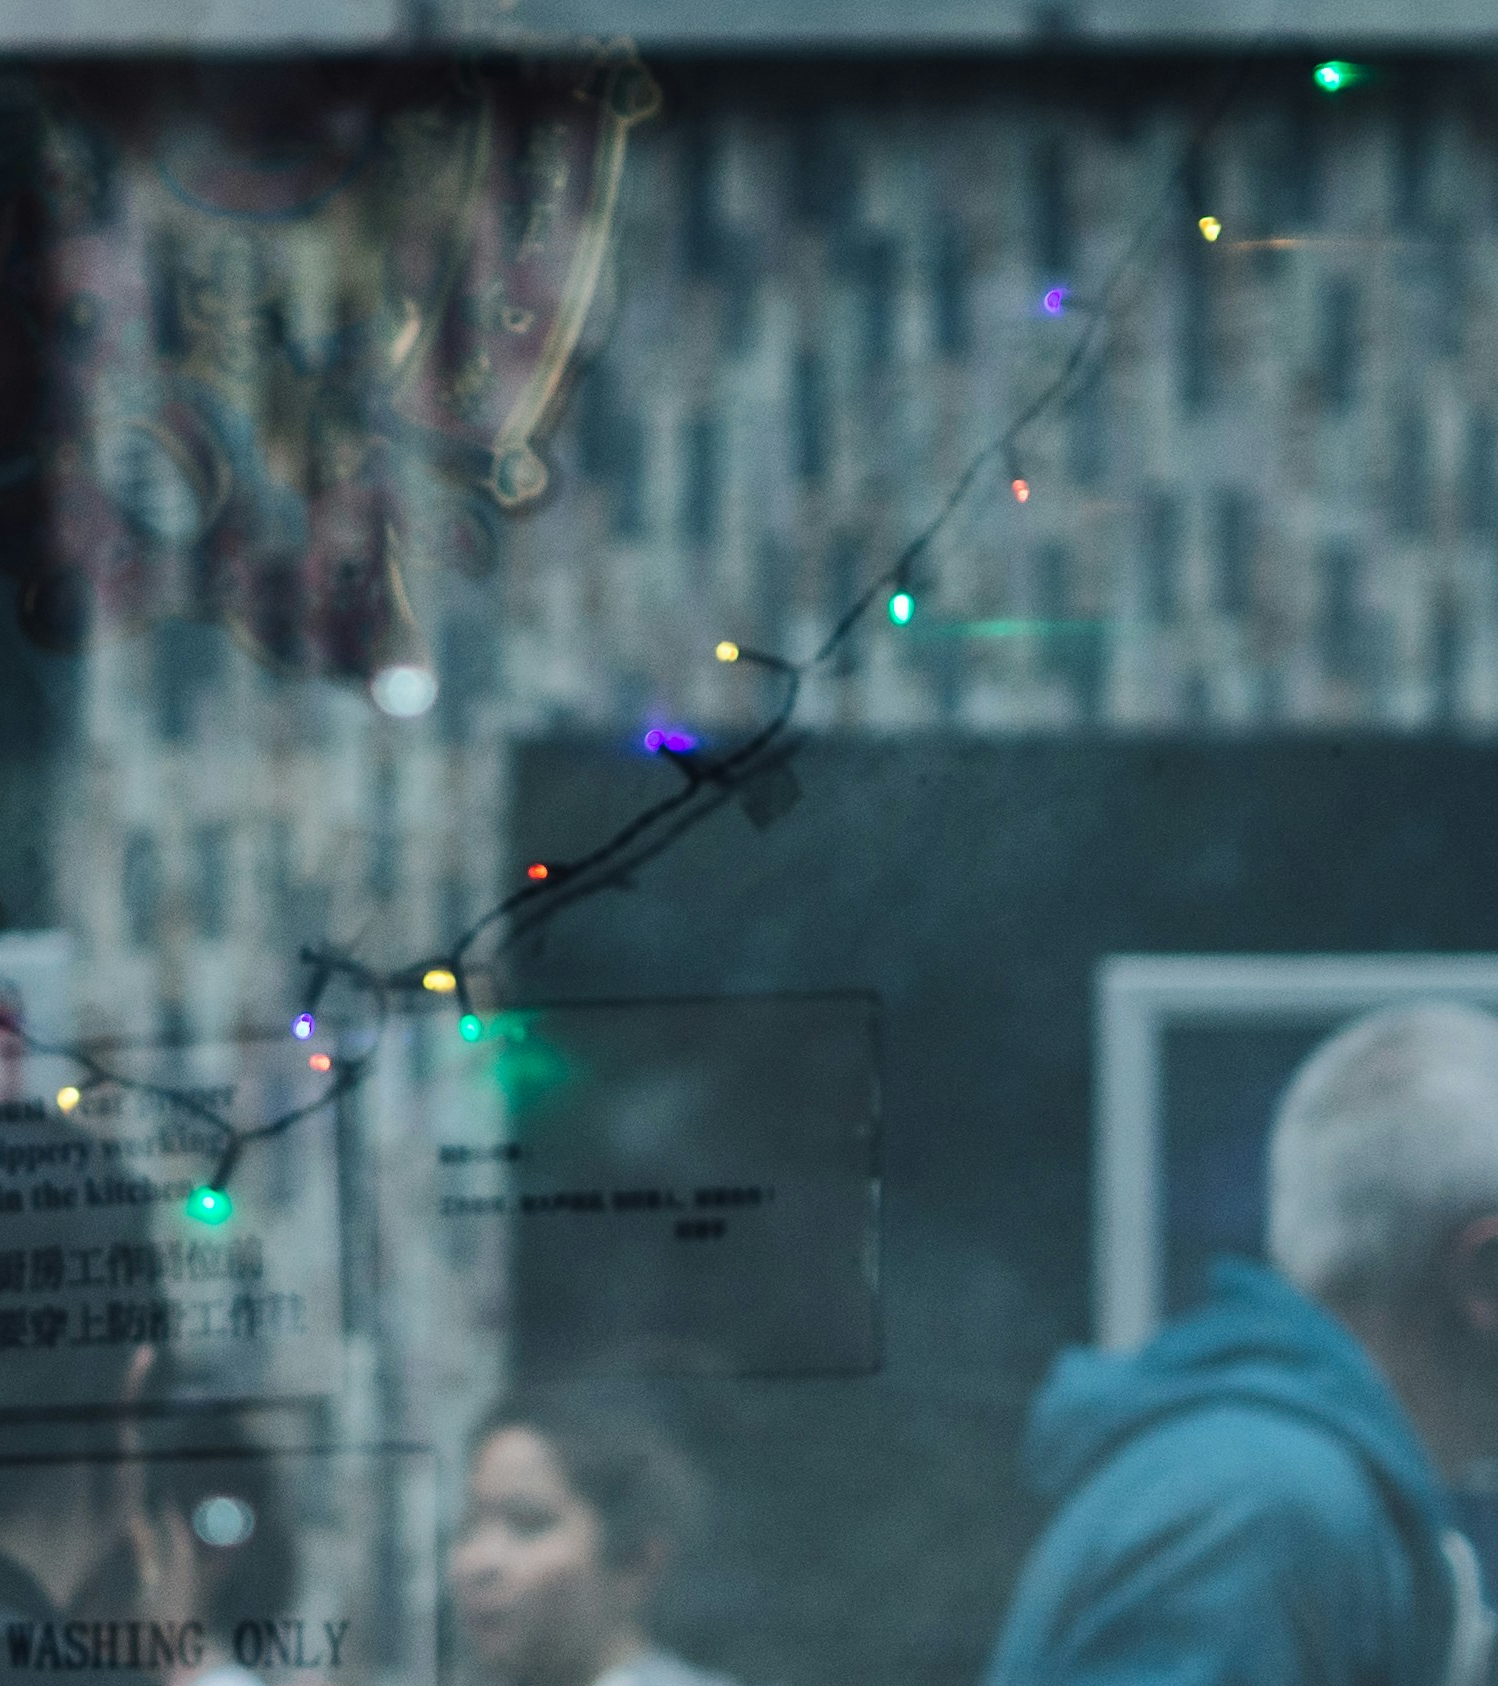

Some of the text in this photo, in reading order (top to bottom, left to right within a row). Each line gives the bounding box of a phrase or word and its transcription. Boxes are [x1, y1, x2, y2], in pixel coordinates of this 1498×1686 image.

[31, 1179, 78, 1209] the
[6, 1619, 205, 1671] WASHING
[232, 1618, 350, 1669] ONLY
